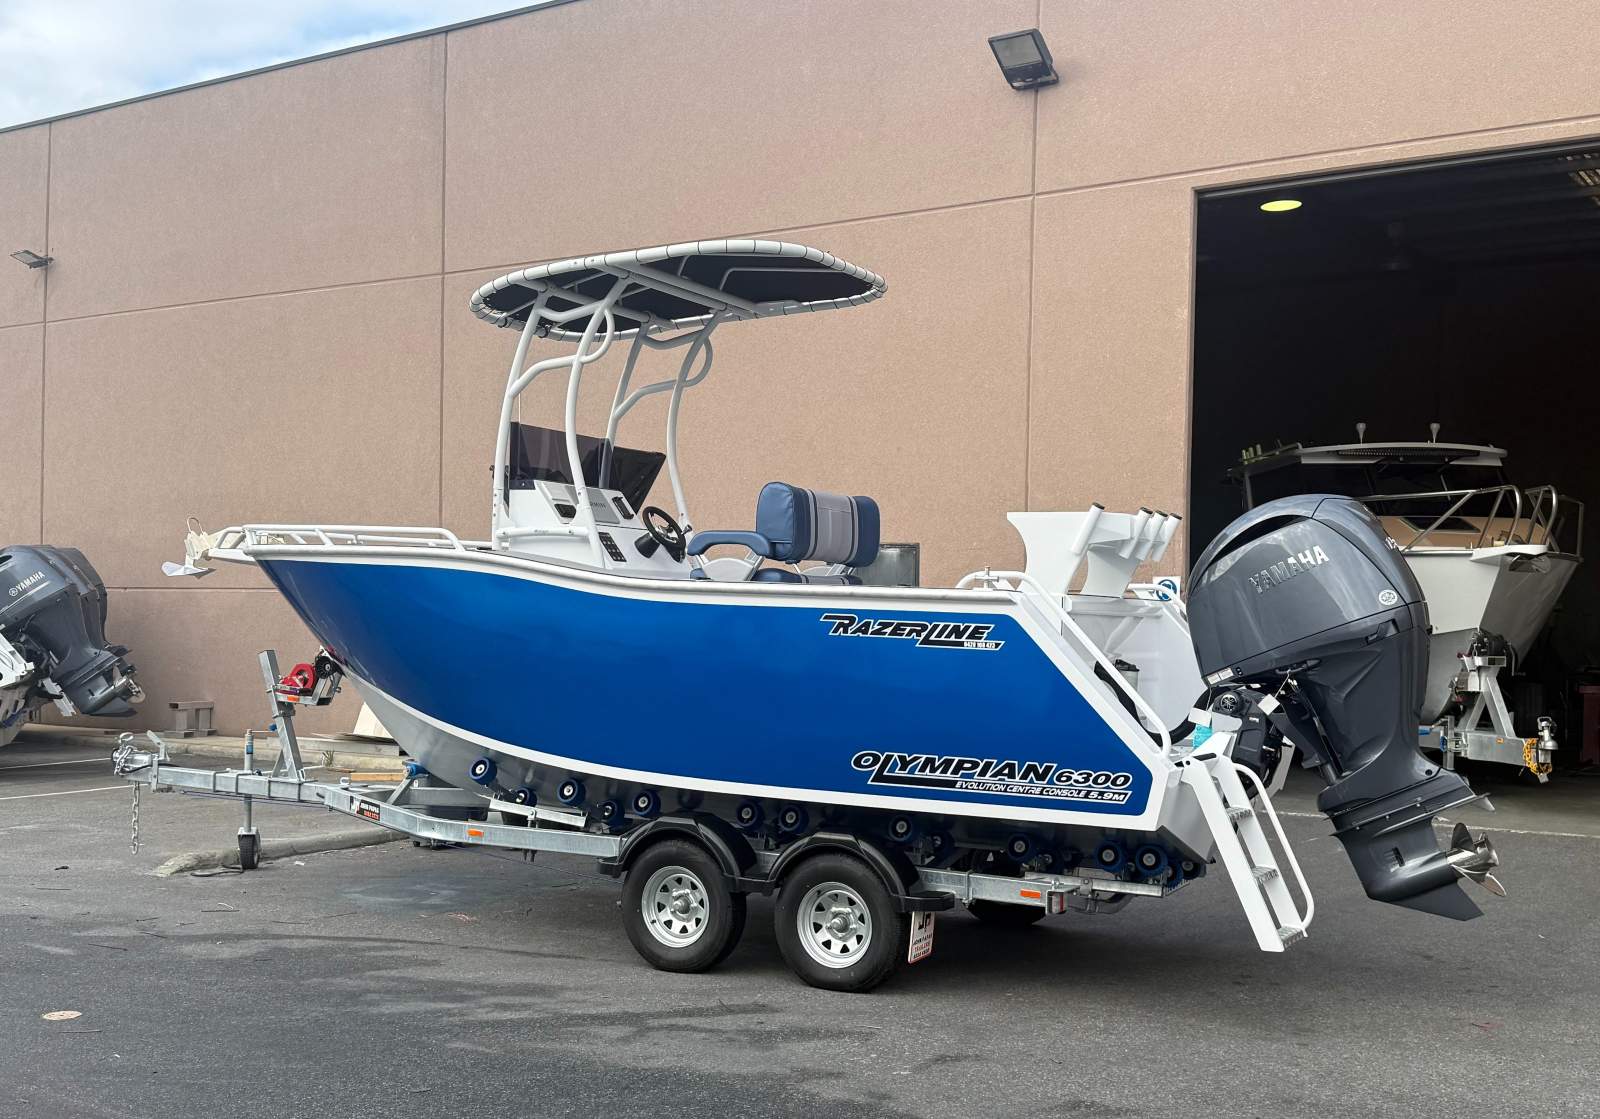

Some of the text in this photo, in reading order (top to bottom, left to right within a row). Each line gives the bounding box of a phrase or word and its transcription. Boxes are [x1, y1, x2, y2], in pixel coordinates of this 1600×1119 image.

[16, 571, 46, 592] YAMAHA
[1248, 545, 1330, 594] YAMAHA
[820, 613, 998, 648] RAZERLINE
[851, 751, 1133, 790] OLYMPIAN 6300
[955, 781, 1126, 802] EVOLUTION CENTRE CONSOLE 5.9M
